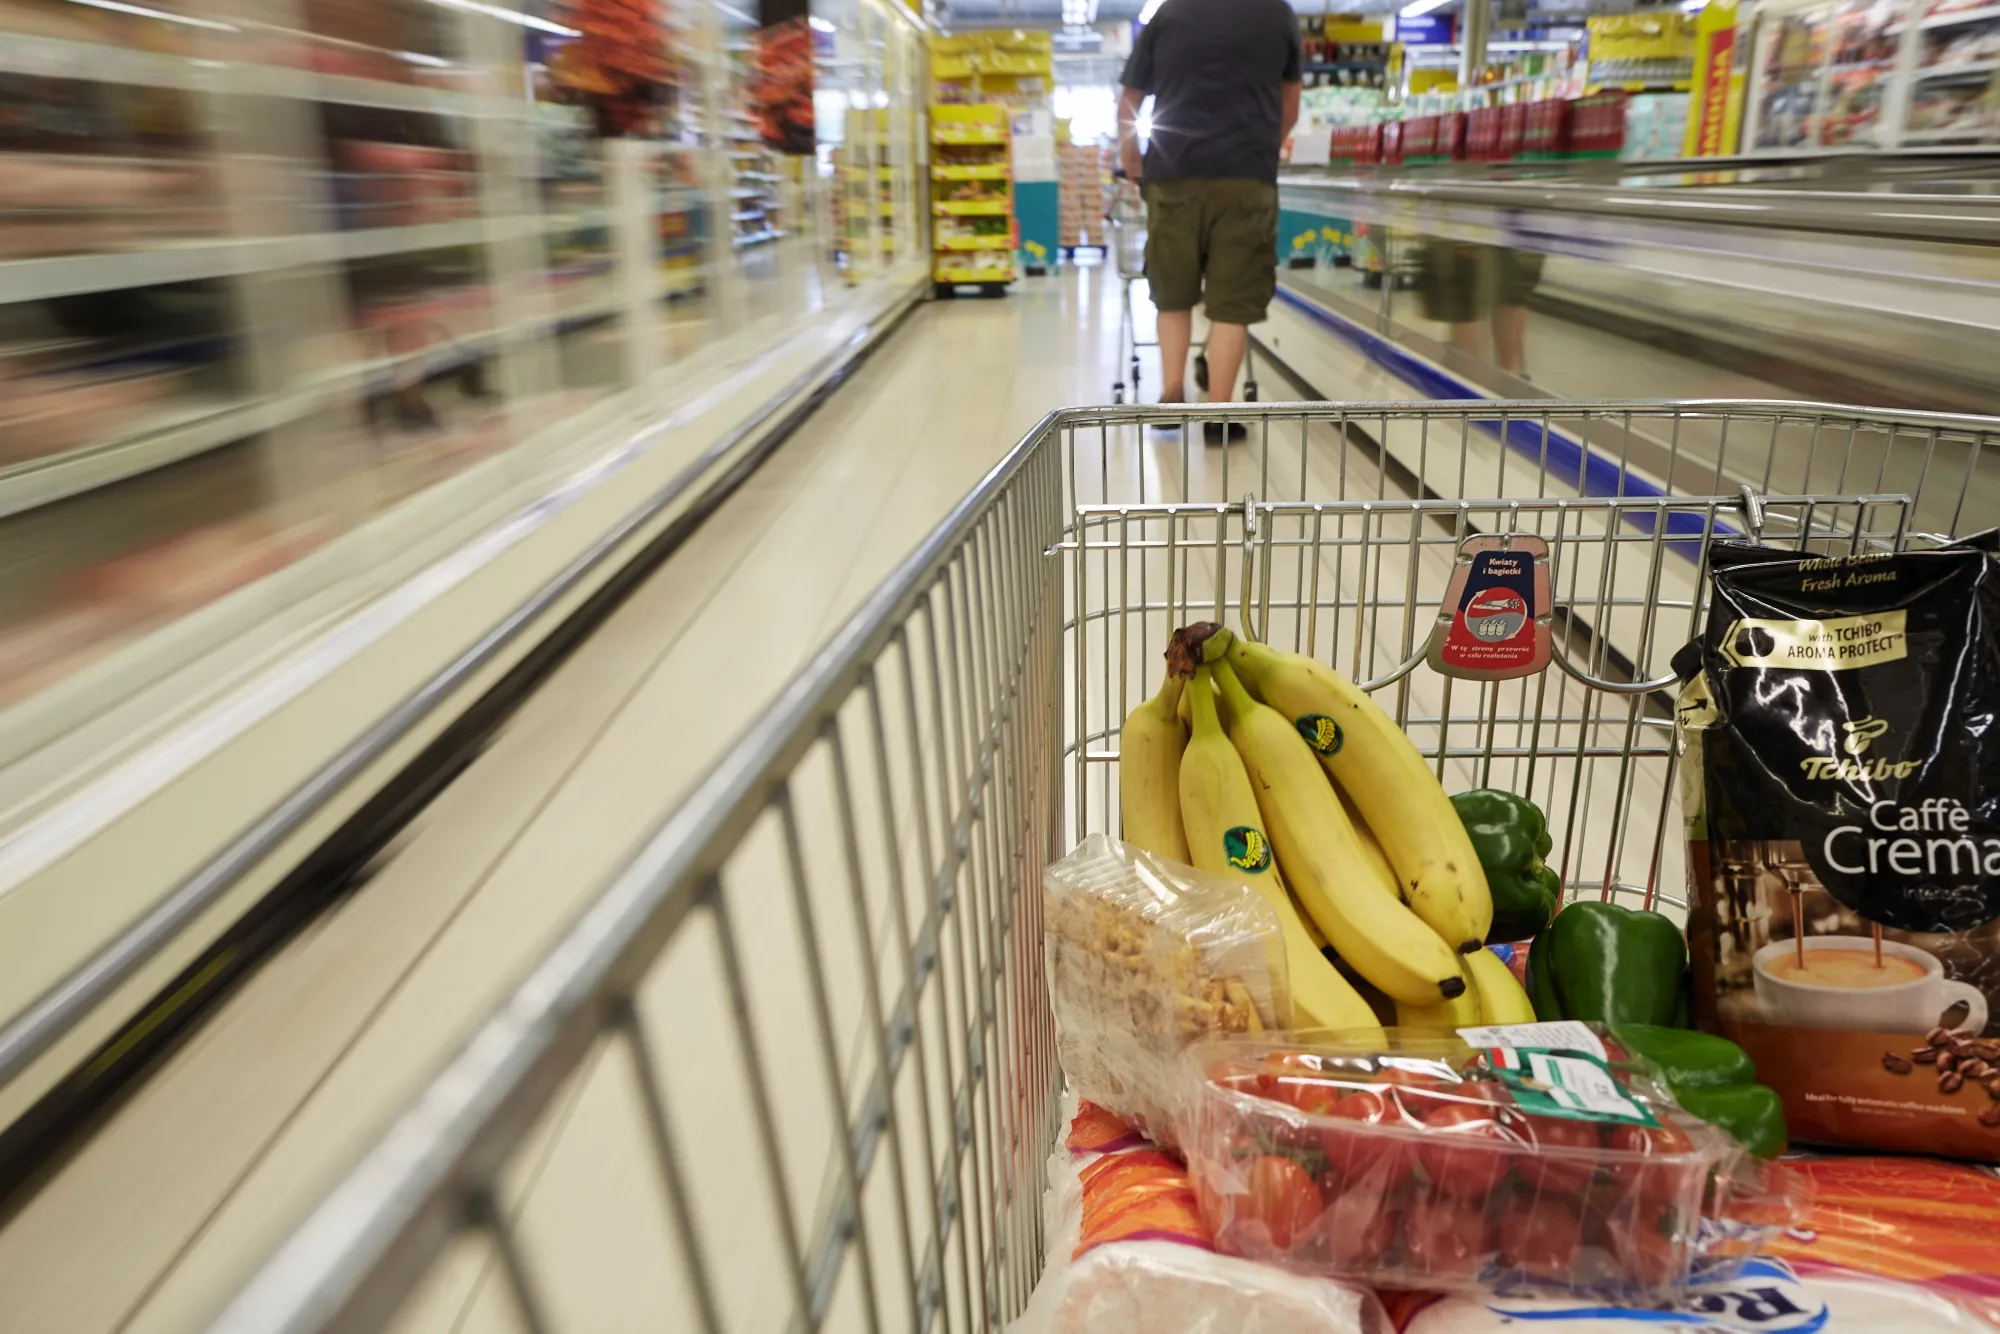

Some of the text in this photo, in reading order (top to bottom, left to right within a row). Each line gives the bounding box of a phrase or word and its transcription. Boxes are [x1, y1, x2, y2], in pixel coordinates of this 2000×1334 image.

[1488, 567, 1521, 576] bagietki
[1489, 558, 1518, 567] Kwiaty
[1801, 571, 1897, 592] Fresh Aroma
[1808, 622, 1882, 642] with TCHIBO
[1788, 645, 1835, 659] AROMA
[1800, 756, 1923, 781] Tchibo
[1870, 798, 1969, 832] Caffè
